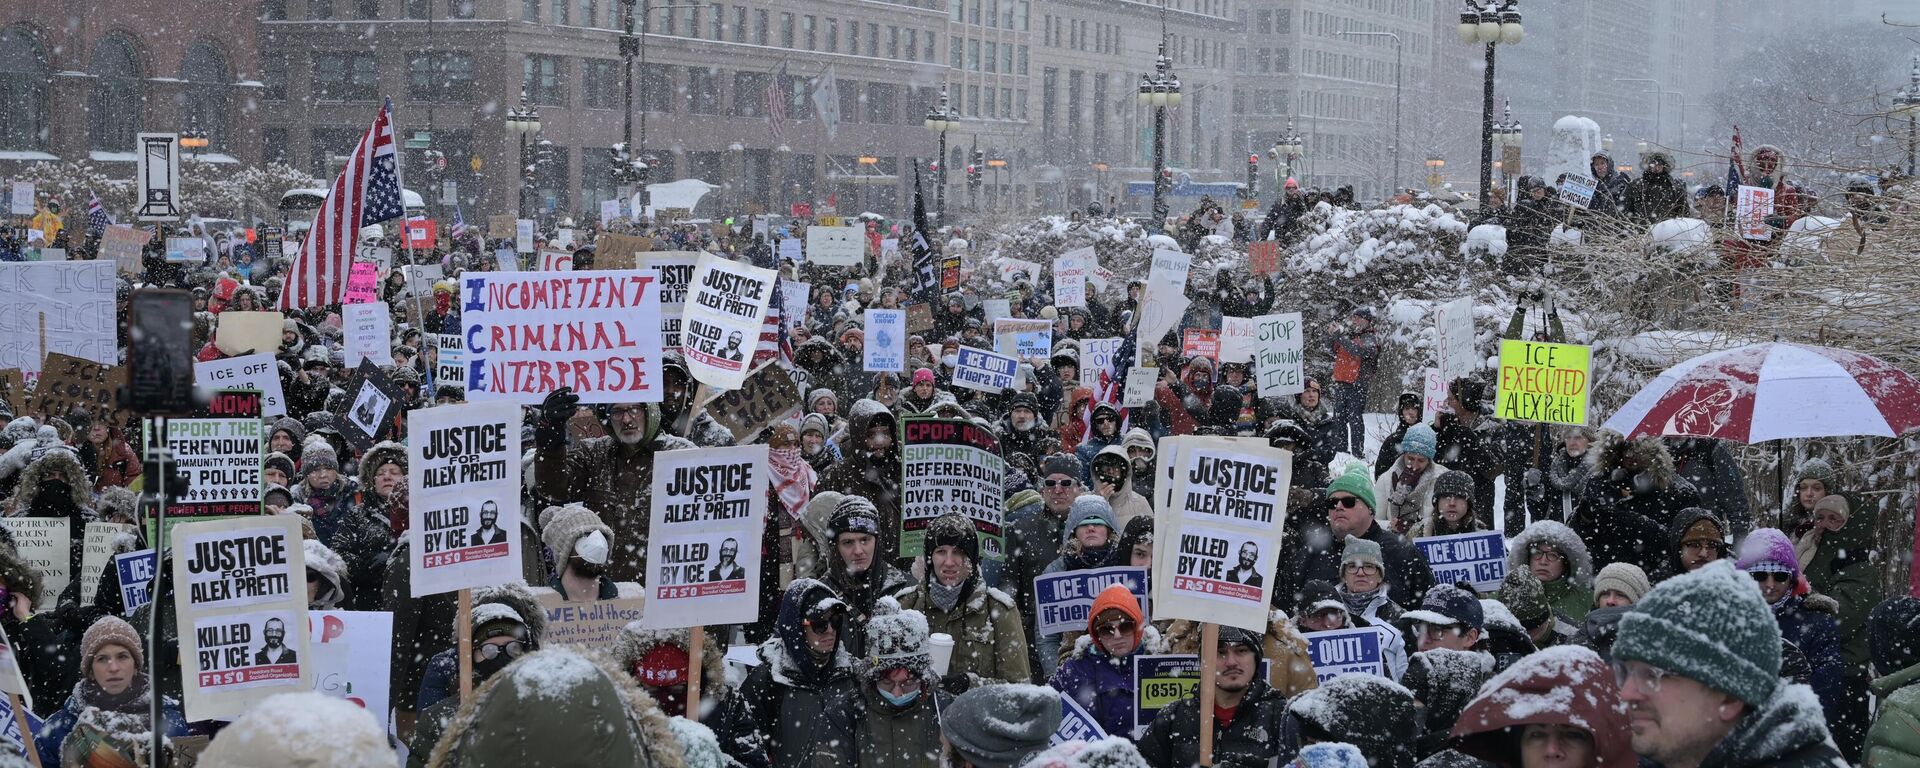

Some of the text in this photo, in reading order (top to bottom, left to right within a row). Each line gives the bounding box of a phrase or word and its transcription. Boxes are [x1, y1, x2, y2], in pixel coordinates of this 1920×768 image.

[1567, 172, 1596, 190] HANDS OFF
[1561, 190, 1590, 208] CHICAGO
[544, 255, 572, 272] IC
[652, 264, 696, 285] USTIC
[1055, 268, 1084, 277] FUNDING
[1062, 261, 1074, 269] NO
[55, 264, 113, 293] ICE
[702, 268, 764, 301] JUSTICE
[464, 276, 655, 313] INCOMPETENT
[660, 290, 673, 303] EX
[696, 290, 724, 310] ALEX
[723, 300, 759, 319] PRETTI
[719, 291, 742, 302] FOR
[0, 301, 113, 333] CK ICE
[661, 319, 682, 332] LLED
[467, 320, 636, 353] CRIMINAL
[689, 319, 723, 341] KILLED
[1224, 320, 1255, 337] Abolis
[1259, 320, 1296, 341] STOP
[440, 336, 463, 349] HAN
[666, 334, 682, 347] ICE
[687, 333, 717, 355] BY ICE
[1086, 340, 1120, 354] ICE
[0, 339, 113, 371] CK ICE
[966, 352, 1009, 374] ICE OUT!
[1260, 347, 1303, 369] FUNDING
[1525, 344, 1559, 368] ICE
[210, 363, 269, 381] ICE OFF
[468, 356, 649, 394] ENTERPRISE
[992, 375, 1013, 390] ICE!
[1264, 367, 1300, 391] ICE!
[1503, 366, 1585, 396] EXECUTED
[209, 394, 260, 415] NOW!
[1505, 392, 1575, 422] ALEX Pretti
[228, 421, 258, 437] THE
[906, 423, 955, 441] CPOP
[422, 423, 507, 460] JUSTICE
[228, 457, 260, 467] POWER
[450, 455, 480, 465] FOR
[906, 447, 1001, 470] SUPPORT THE
[200, 469, 260, 486] POLICE
[423, 460, 506, 489] ALEX PRETTI
[666, 463, 753, 497] JUSTICE
[906, 462, 1001, 487] REFERENDUM
[1189, 456, 1279, 496] JUSTICE
[694, 493, 725, 503] FOR
[906, 478, 1001, 496] FOR COMMUNITY POWER
[1216, 487, 1247, 499] FOR
[168, 504, 259, 515] POWER TO THE PEOPLE
[664, 498, 750, 524] ALEX PRETTI
[905, 489, 1001, 512] OVER POLICE
[1185, 492, 1273, 523] ALEX PRETTI
[7, 520, 65, 528] TOP TRUMP'S
[424, 506, 469, 532] KILLED
[425, 528, 467, 553] BY ICE
[1180, 534, 1229, 559] KILLED
[1427, 539, 1491, 563] ICE OUT!
[187, 535, 287, 574] JUSTICE
[425, 552, 461, 568] FRSO
[661, 543, 709, 565] KILLED
[129, 557, 153, 581] ICE
[221, 567, 257, 579] FOR
[660, 564, 705, 585] BY ICE
[1177, 556, 1223, 580] BY ICE
[1474, 560, 1504, 583] ICE!
[191, 573, 289, 604] ALEX PRETTI
[660, 586, 697, 599] FRSO
[1053, 577, 1083, 600] ICE
[1176, 578, 1214, 593] FRSO
[547, 603, 639, 622] WE hold these
[1043, 604, 1091, 625] ¡Fuer
[197, 623, 251, 648] KILLED
[549, 624, 586, 638] ruths to
[199, 646, 251, 671] BY ICE
[1319, 637, 1363, 664] OUT!
[202, 670, 244, 686] FRSO
[1058, 711, 1091, 741] ICE
